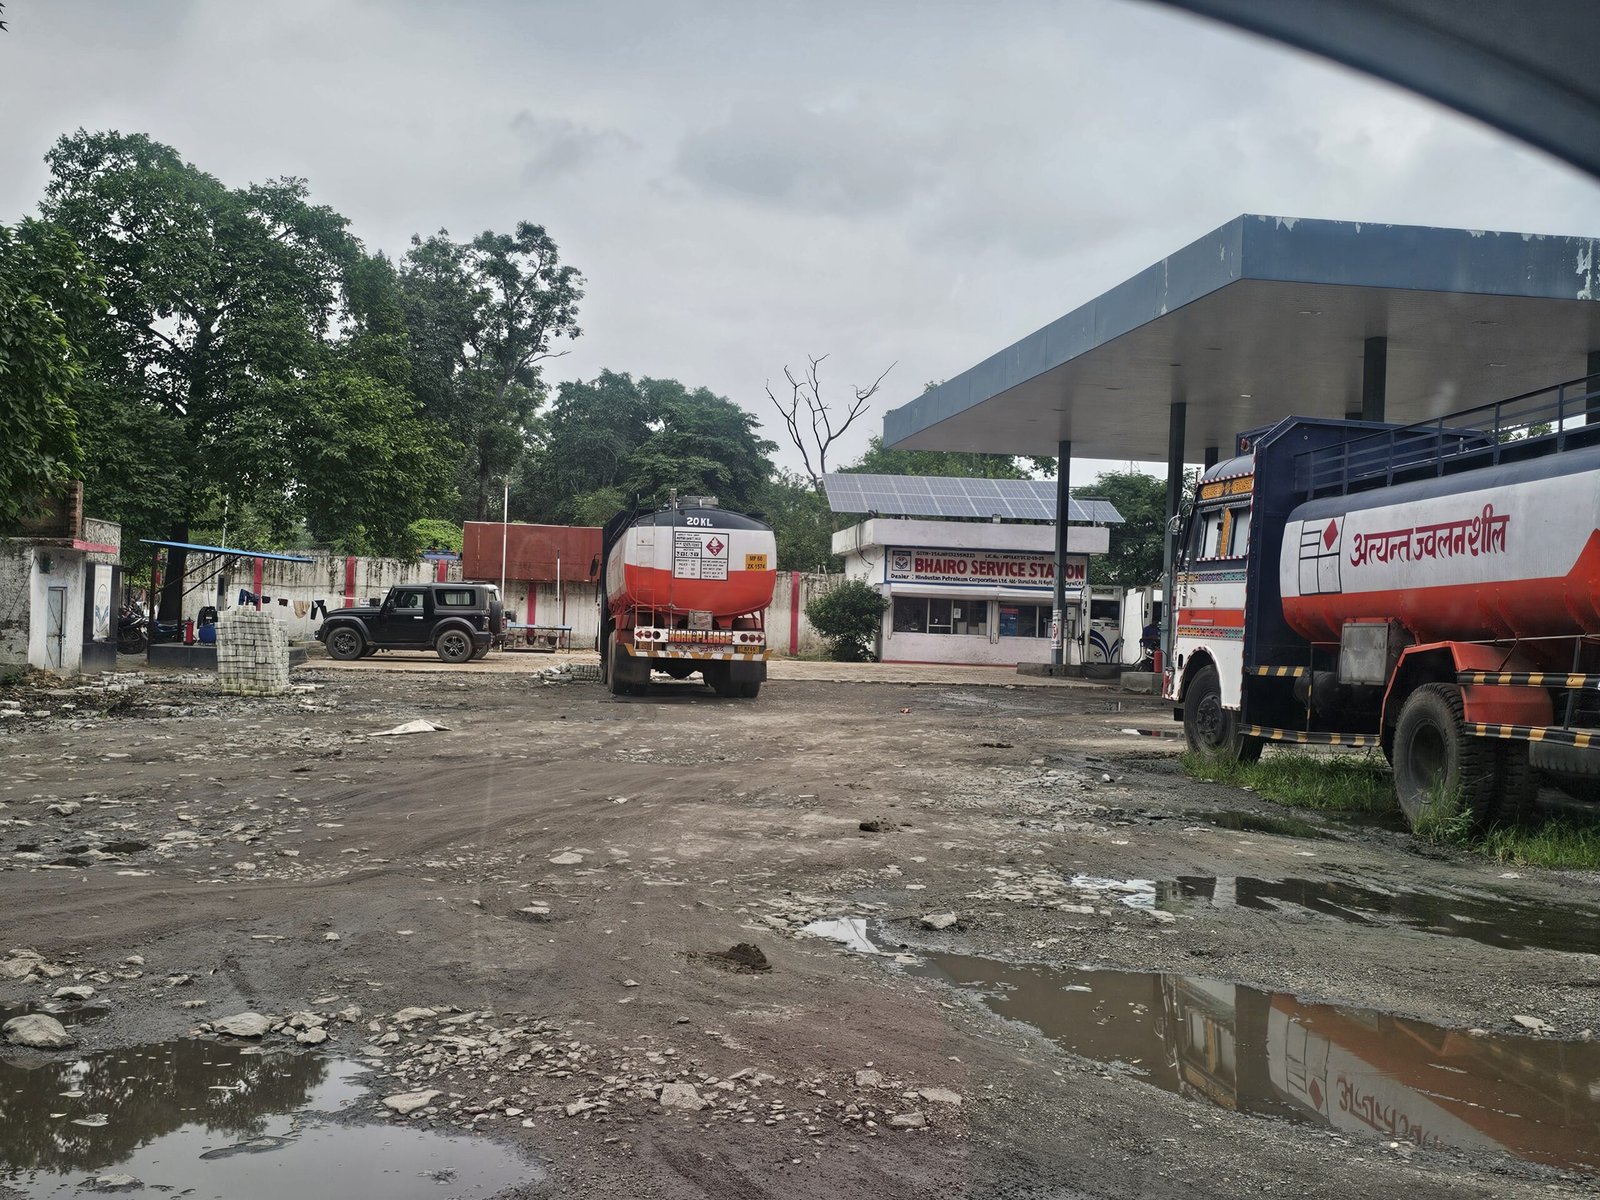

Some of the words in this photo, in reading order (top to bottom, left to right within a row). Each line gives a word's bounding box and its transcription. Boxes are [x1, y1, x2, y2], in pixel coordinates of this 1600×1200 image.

[686, 517, 700, 526] 20
[700, 518, 713, 527] KL
[1350, 528, 1413, 567] अत्यन्त
[1413, 503, 1510, 561] ज्वलनशील
[914, 557, 968, 575] BHAIRO
[970, 560, 1026, 578] SERVICE
[1028, 562, 1085, 579] STAON
[969, 576, 998, 584] Corporation
[669, 629, 692, 643] HORN
[697, 630, 733, 645] PLEASE
